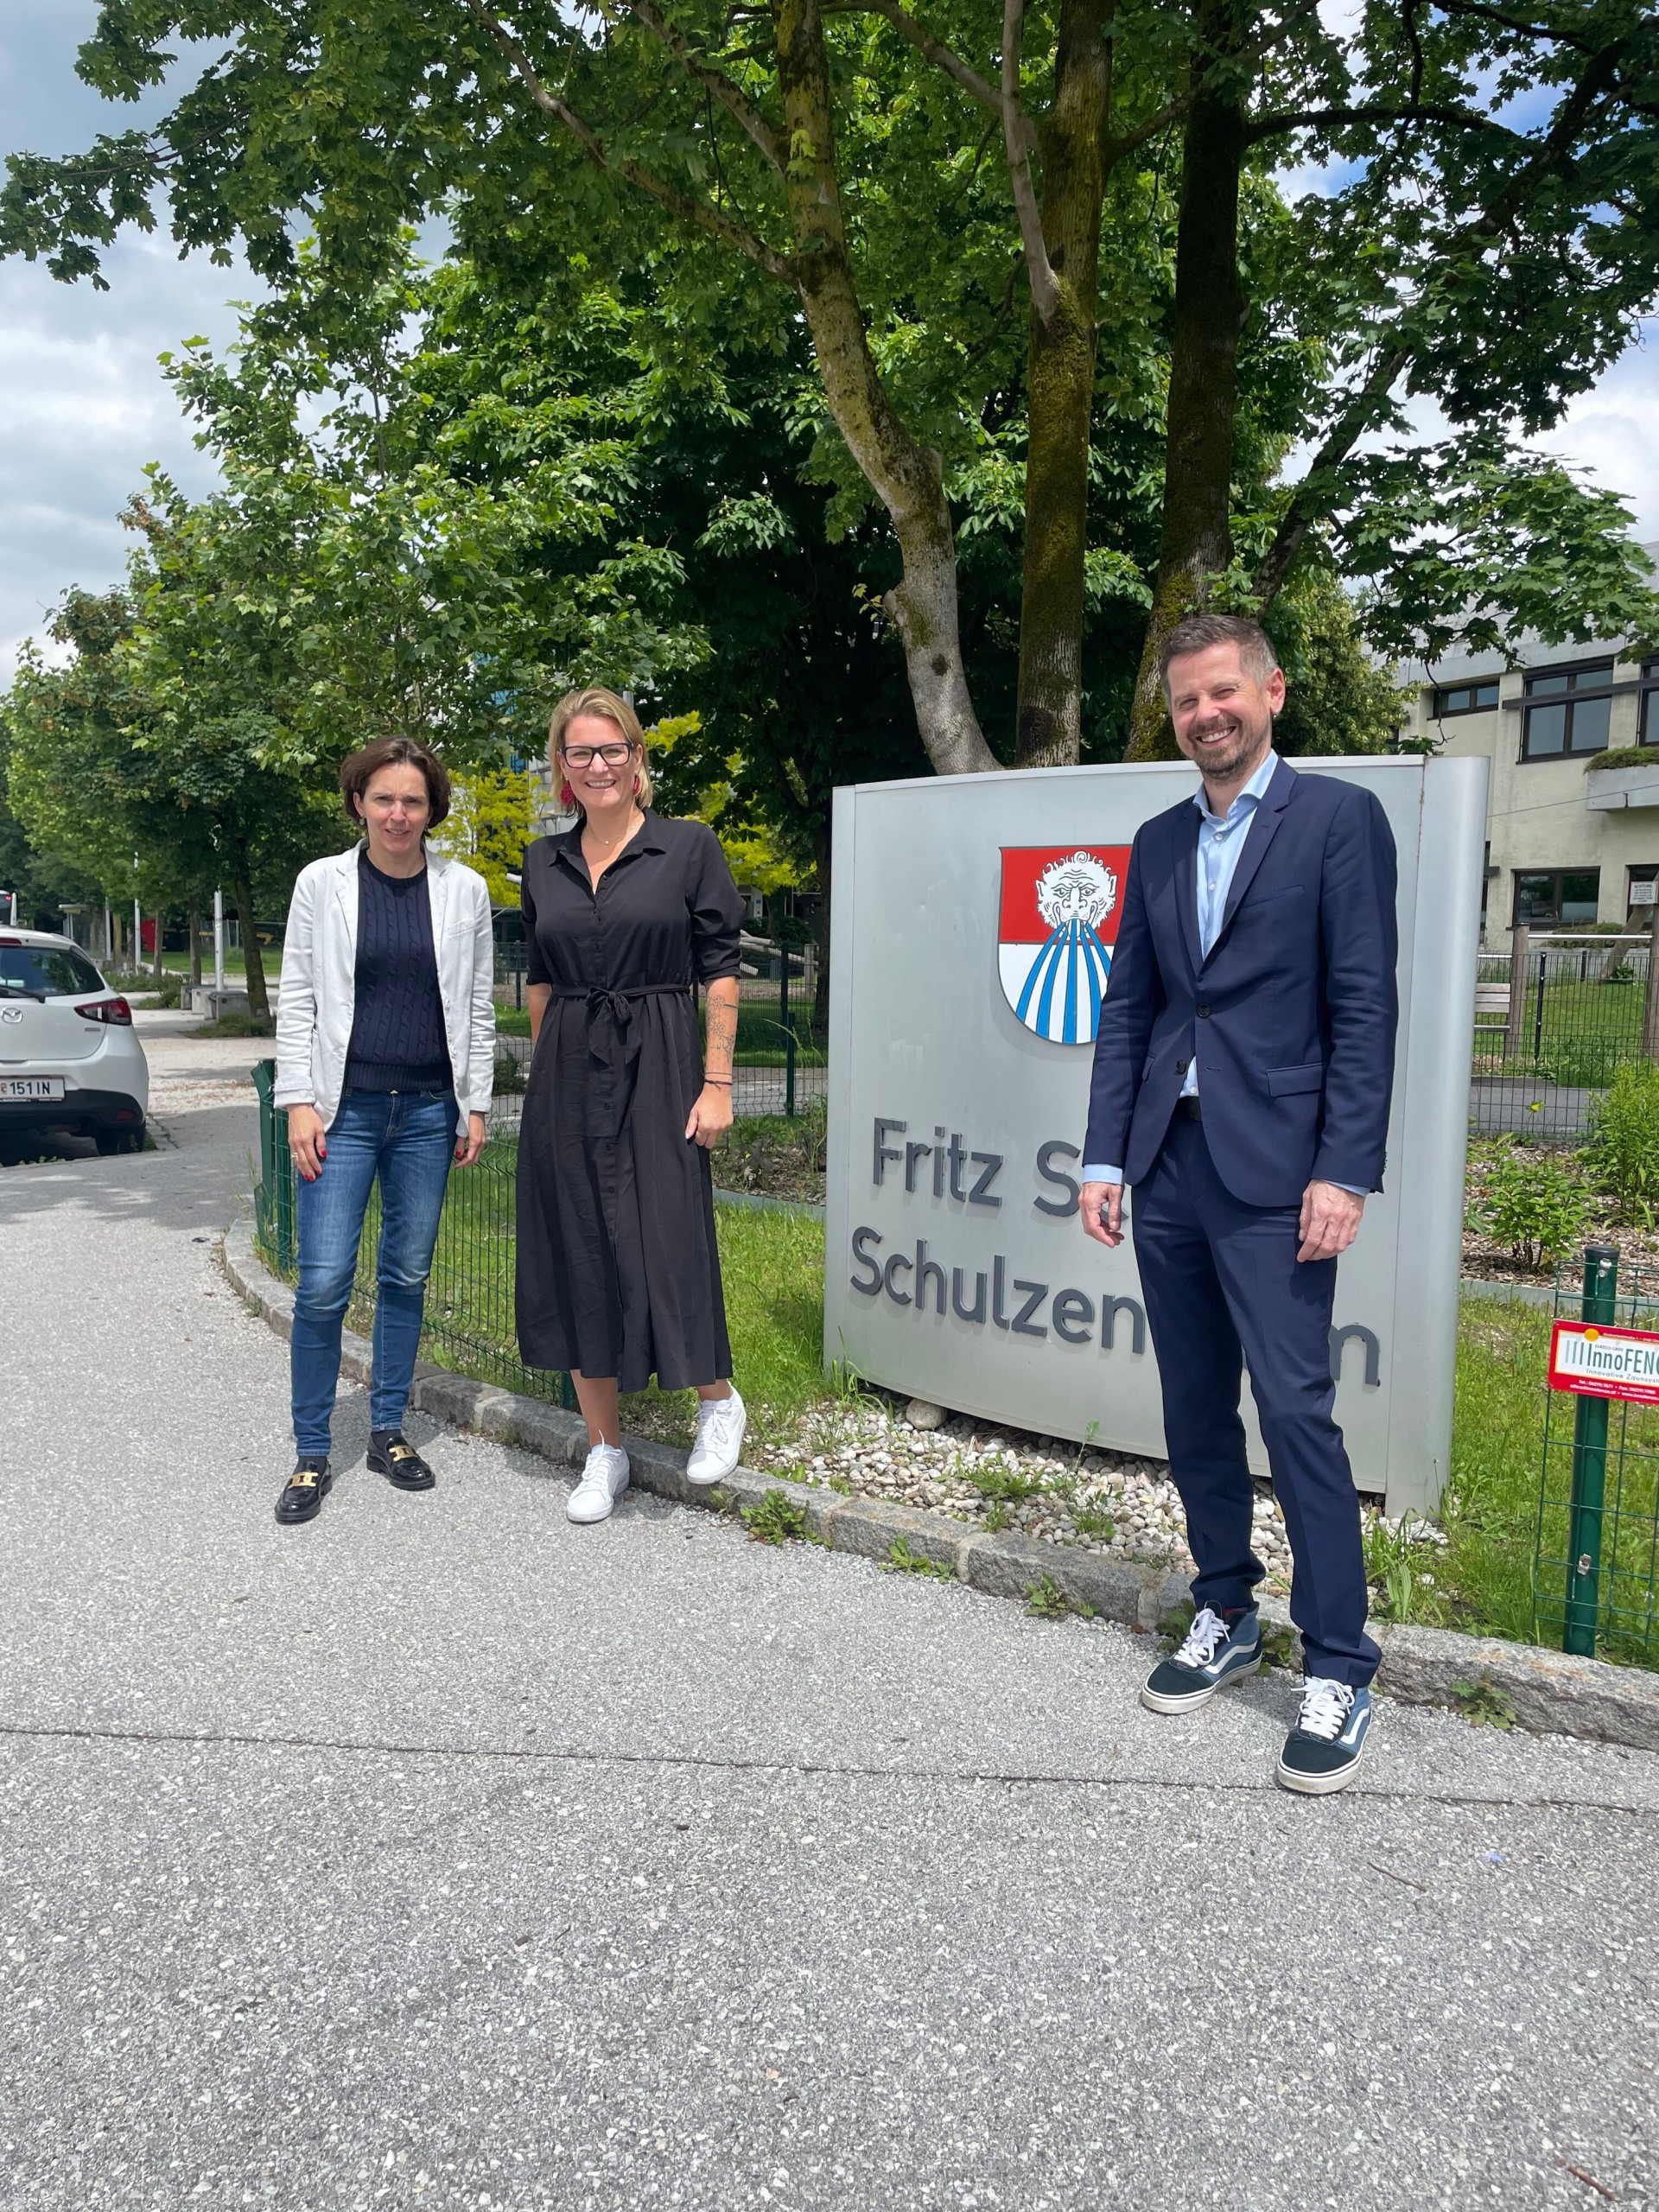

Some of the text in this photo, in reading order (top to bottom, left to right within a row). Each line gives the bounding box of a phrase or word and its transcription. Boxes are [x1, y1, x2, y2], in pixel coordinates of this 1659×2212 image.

[10, 1082, 51, 1095] 151 IN
[873, 1117, 1002, 1207] Fritz
[1586, 1368, 1624, 1379] Innovative
